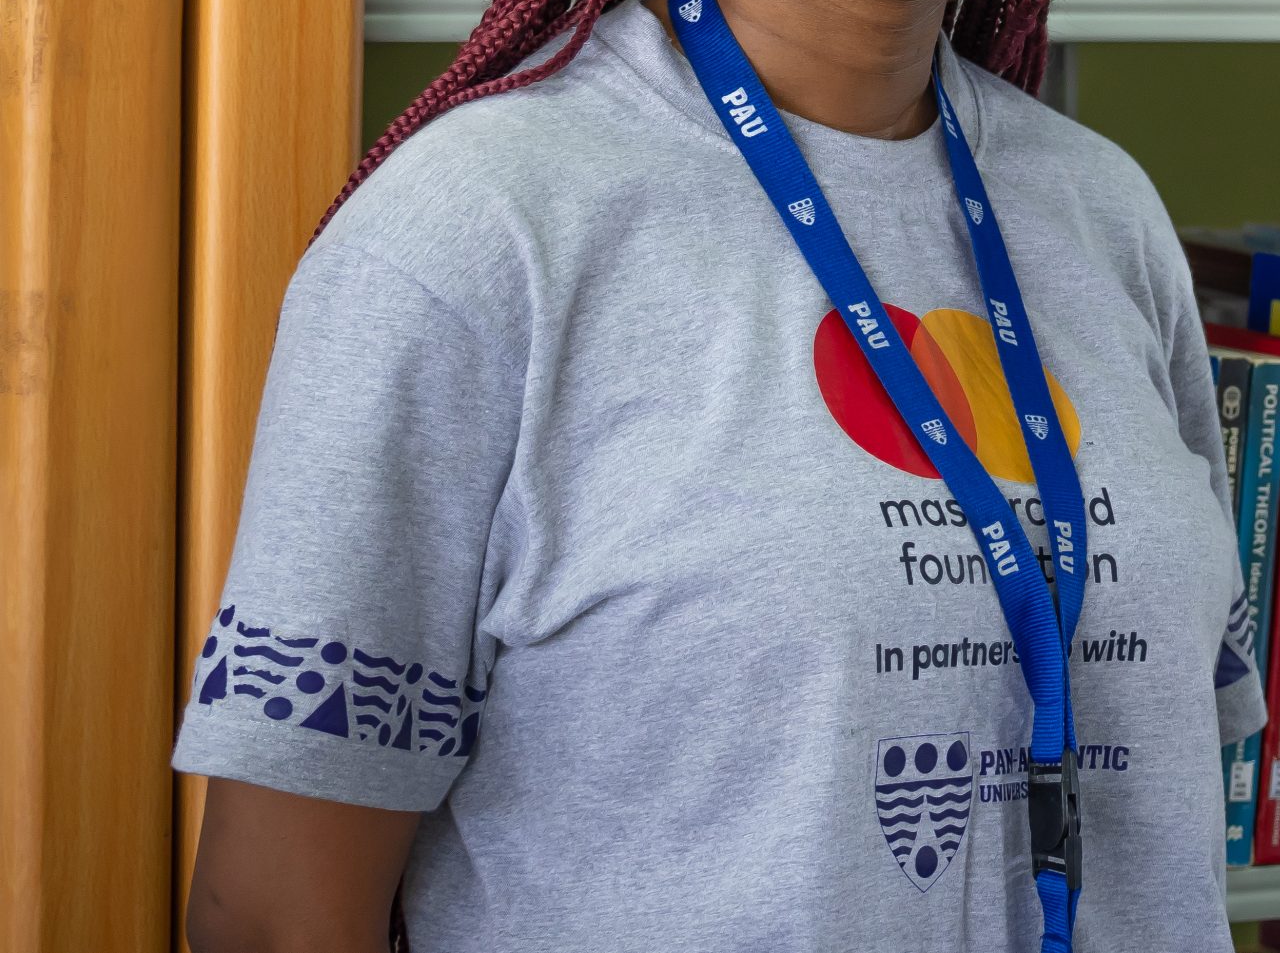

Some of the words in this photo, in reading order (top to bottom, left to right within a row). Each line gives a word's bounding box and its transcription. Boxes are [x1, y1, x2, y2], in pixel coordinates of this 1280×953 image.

[721, 86, 768, 139] PAU
[848, 300, 890, 350] PAU
[989, 297, 1018, 347] PAU
[1227, 427, 1239, 473] POWER
[1258, 383, 1278, 477] POLITICAL
[879, 487, 1116, 527] masrcd
[1252, 484, 1271, 557] THEORY
[899, 541, 1118, 586] fountn
[982, 520, 1020, 577] PAU
[1053, 519, 1075, 575] PAU
[1248, 562, 1260, 601] Ideas
[876, 642, 904, 674] In
[1081, 629, 1148, 663] with
[979, 780, 1029, 803] UNIVERS
